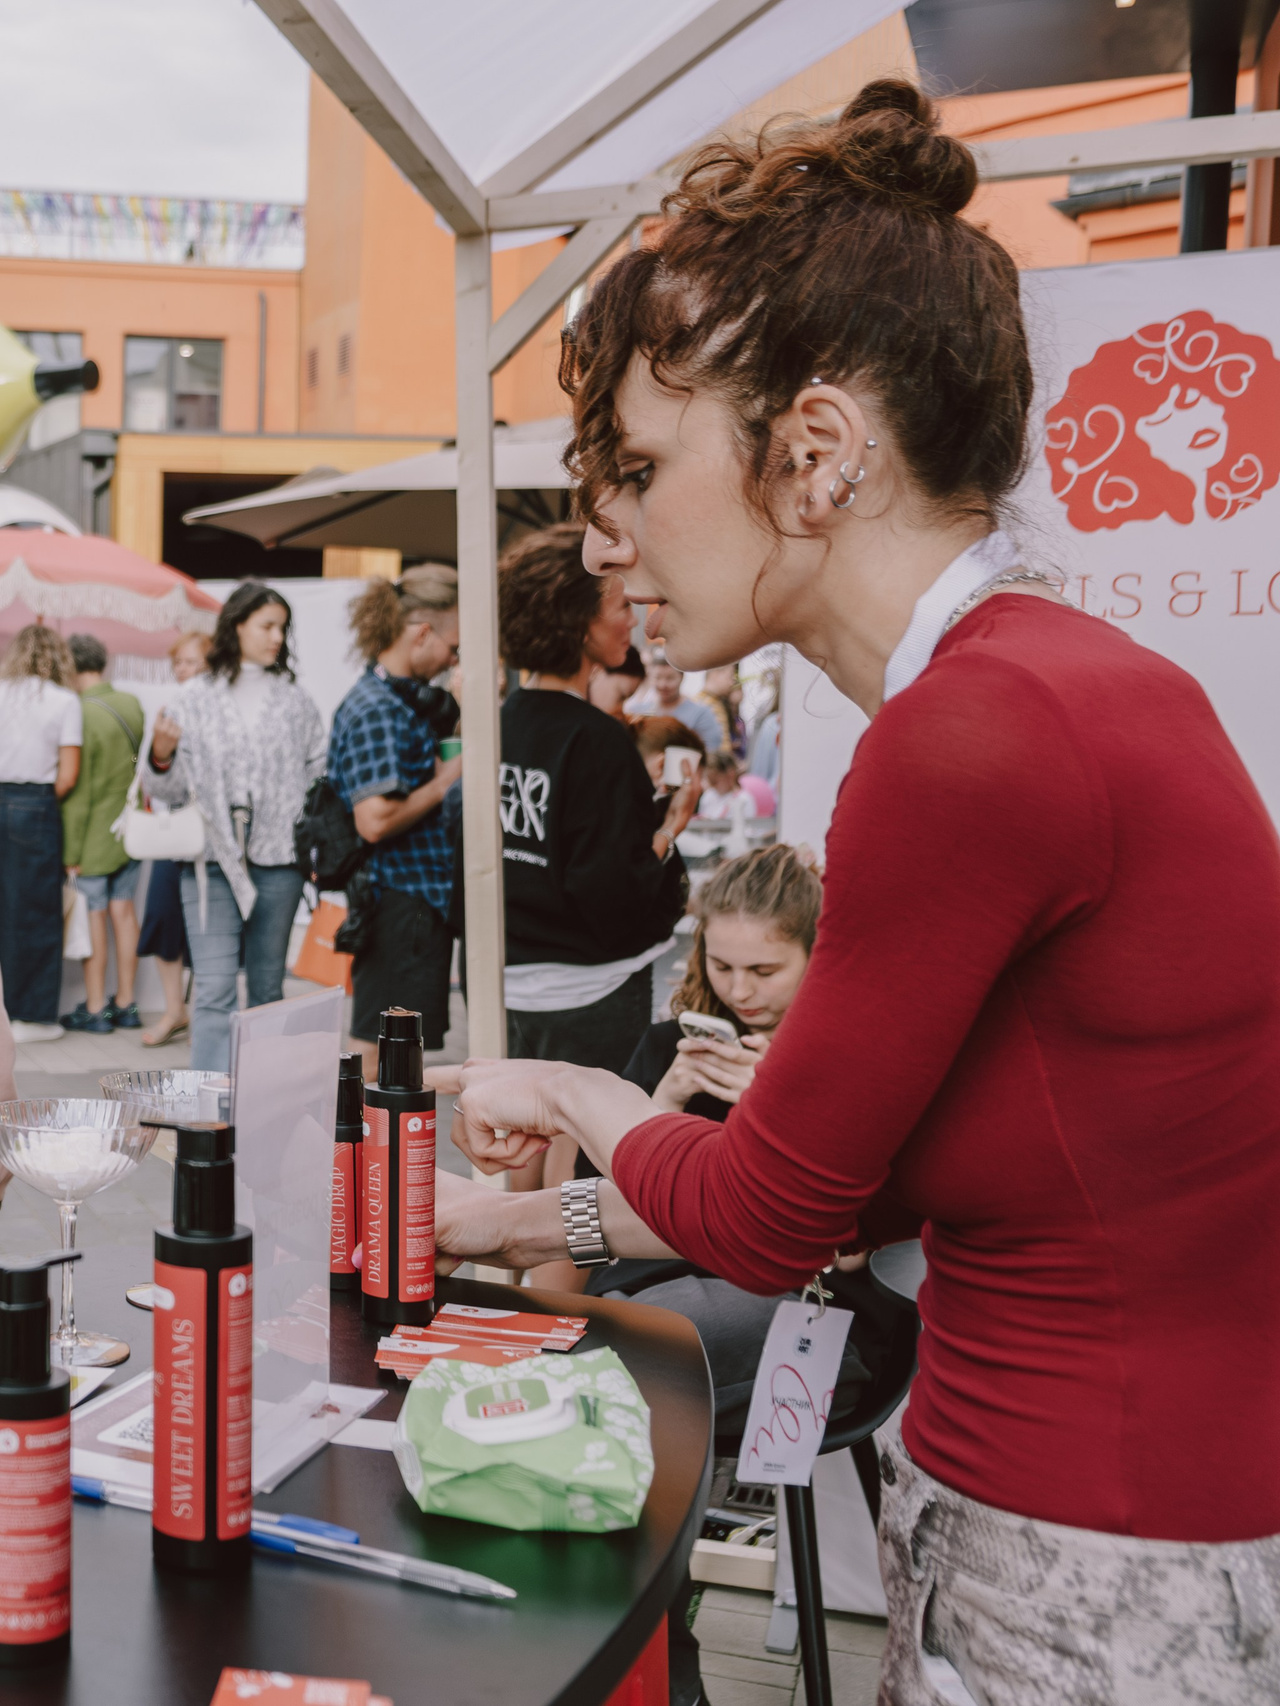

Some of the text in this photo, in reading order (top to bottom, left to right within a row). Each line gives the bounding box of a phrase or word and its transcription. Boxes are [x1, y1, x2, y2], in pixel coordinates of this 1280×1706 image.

[1168, 571, 1208, 618] &
[330, 1166, 348, 1265] MAGIC DROP
[367, 1160, 383, 1284] DRAMA QUEEN
[170, 1318, 195, 1519] SWEET DREAMS
